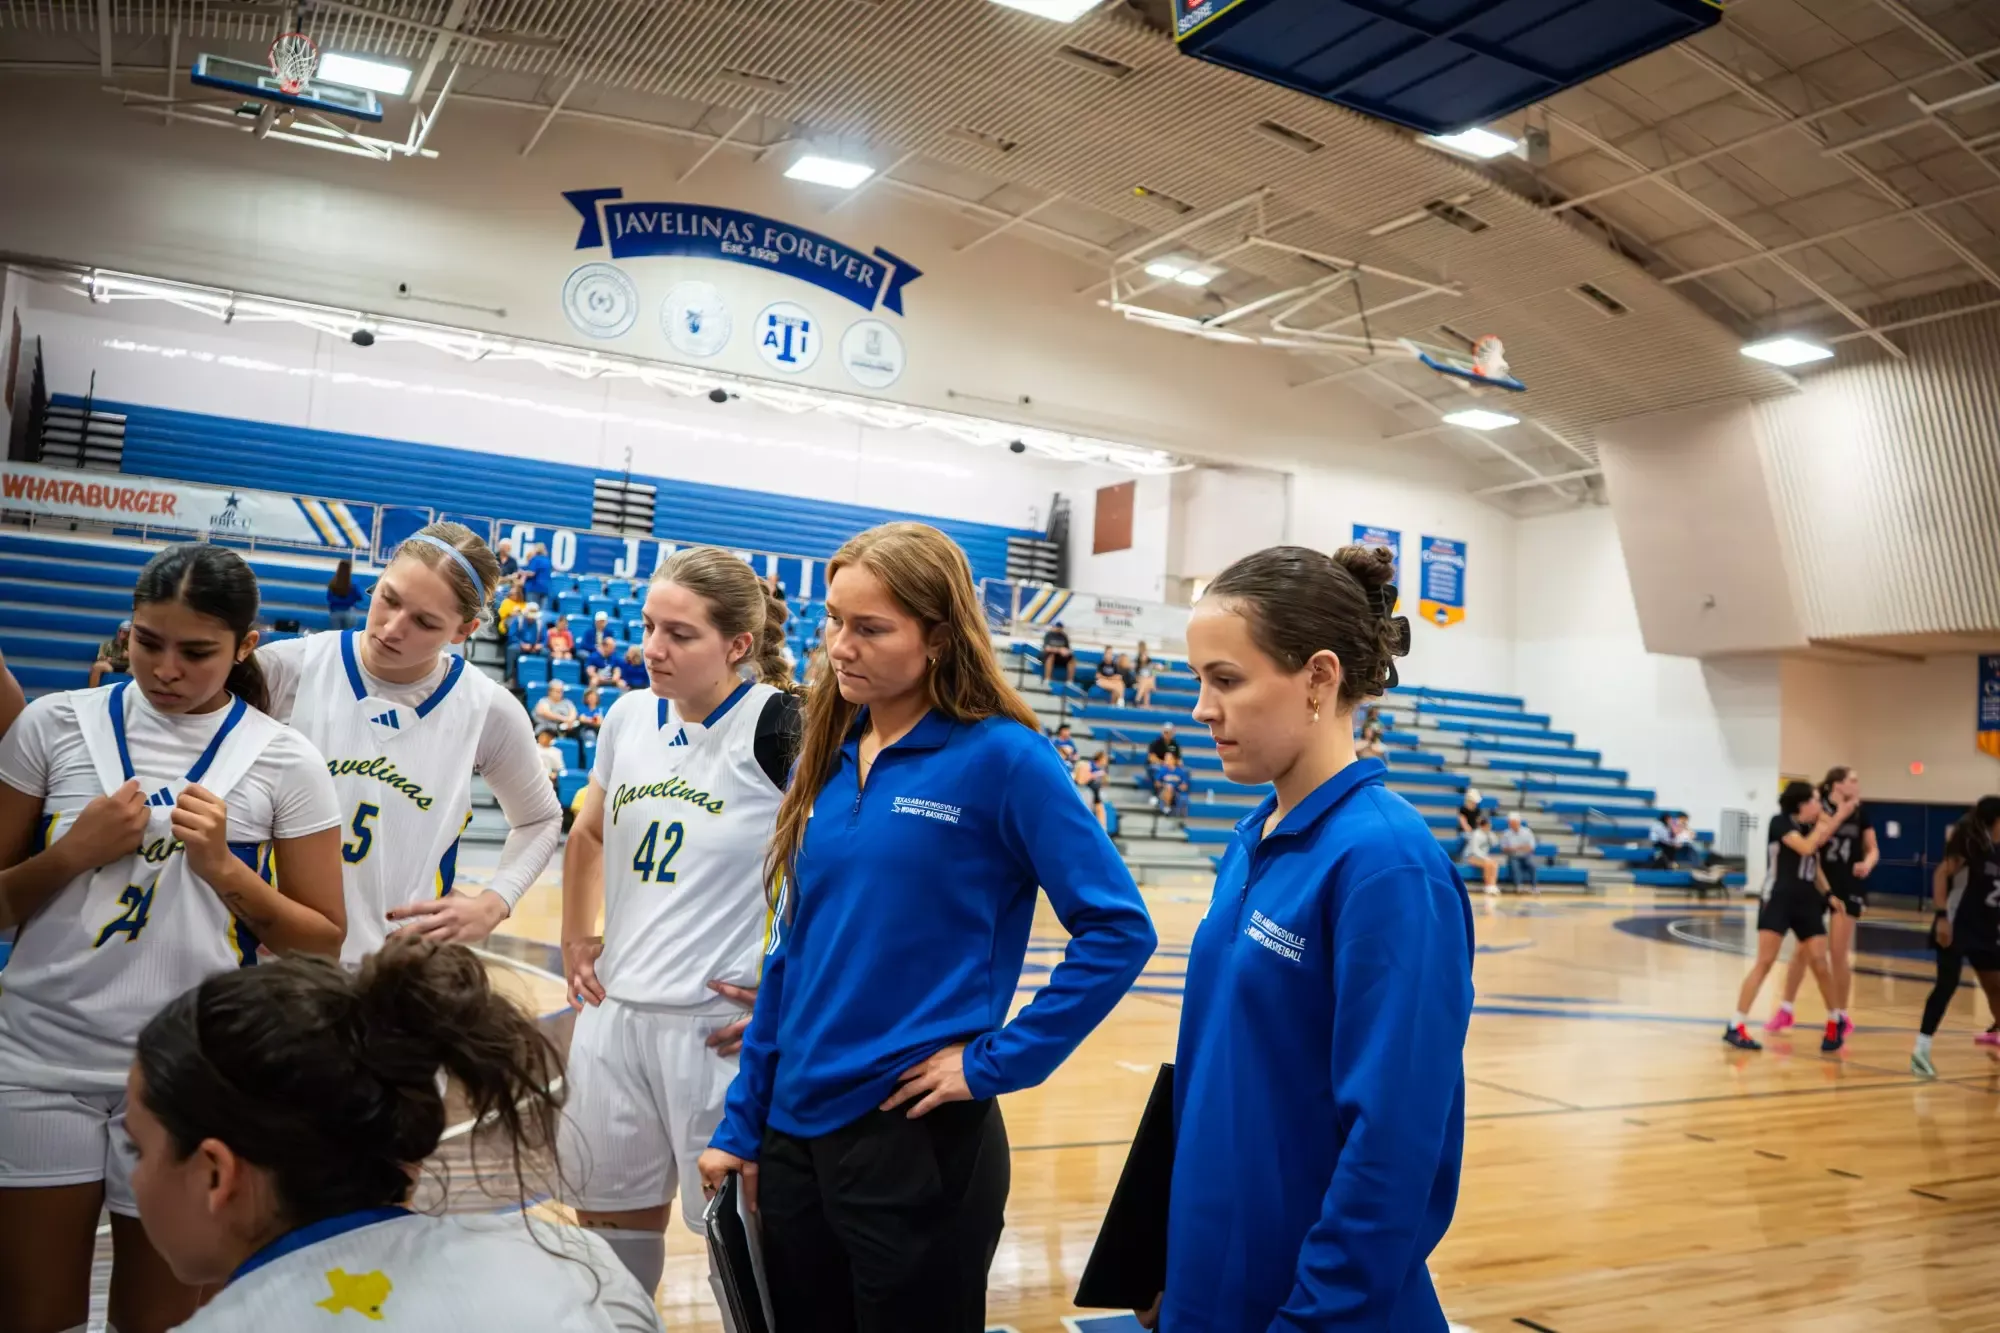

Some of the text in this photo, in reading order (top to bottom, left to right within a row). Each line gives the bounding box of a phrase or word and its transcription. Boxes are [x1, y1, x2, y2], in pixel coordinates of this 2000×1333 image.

[613, 211, 875, 289] JAVELINAS FOREVER
[2, 473, 178, 517] WHATABURGER
[326, 756, 434, 812] avelinas
[612, 776, 725, 826] Javelinas
[924, 800, 962, 814] KINGSVILLE
[341, 801, 380, 866] 5
[925, 810, 959, 824] BASKETBALL
[632, 819, 685, 884] 42
